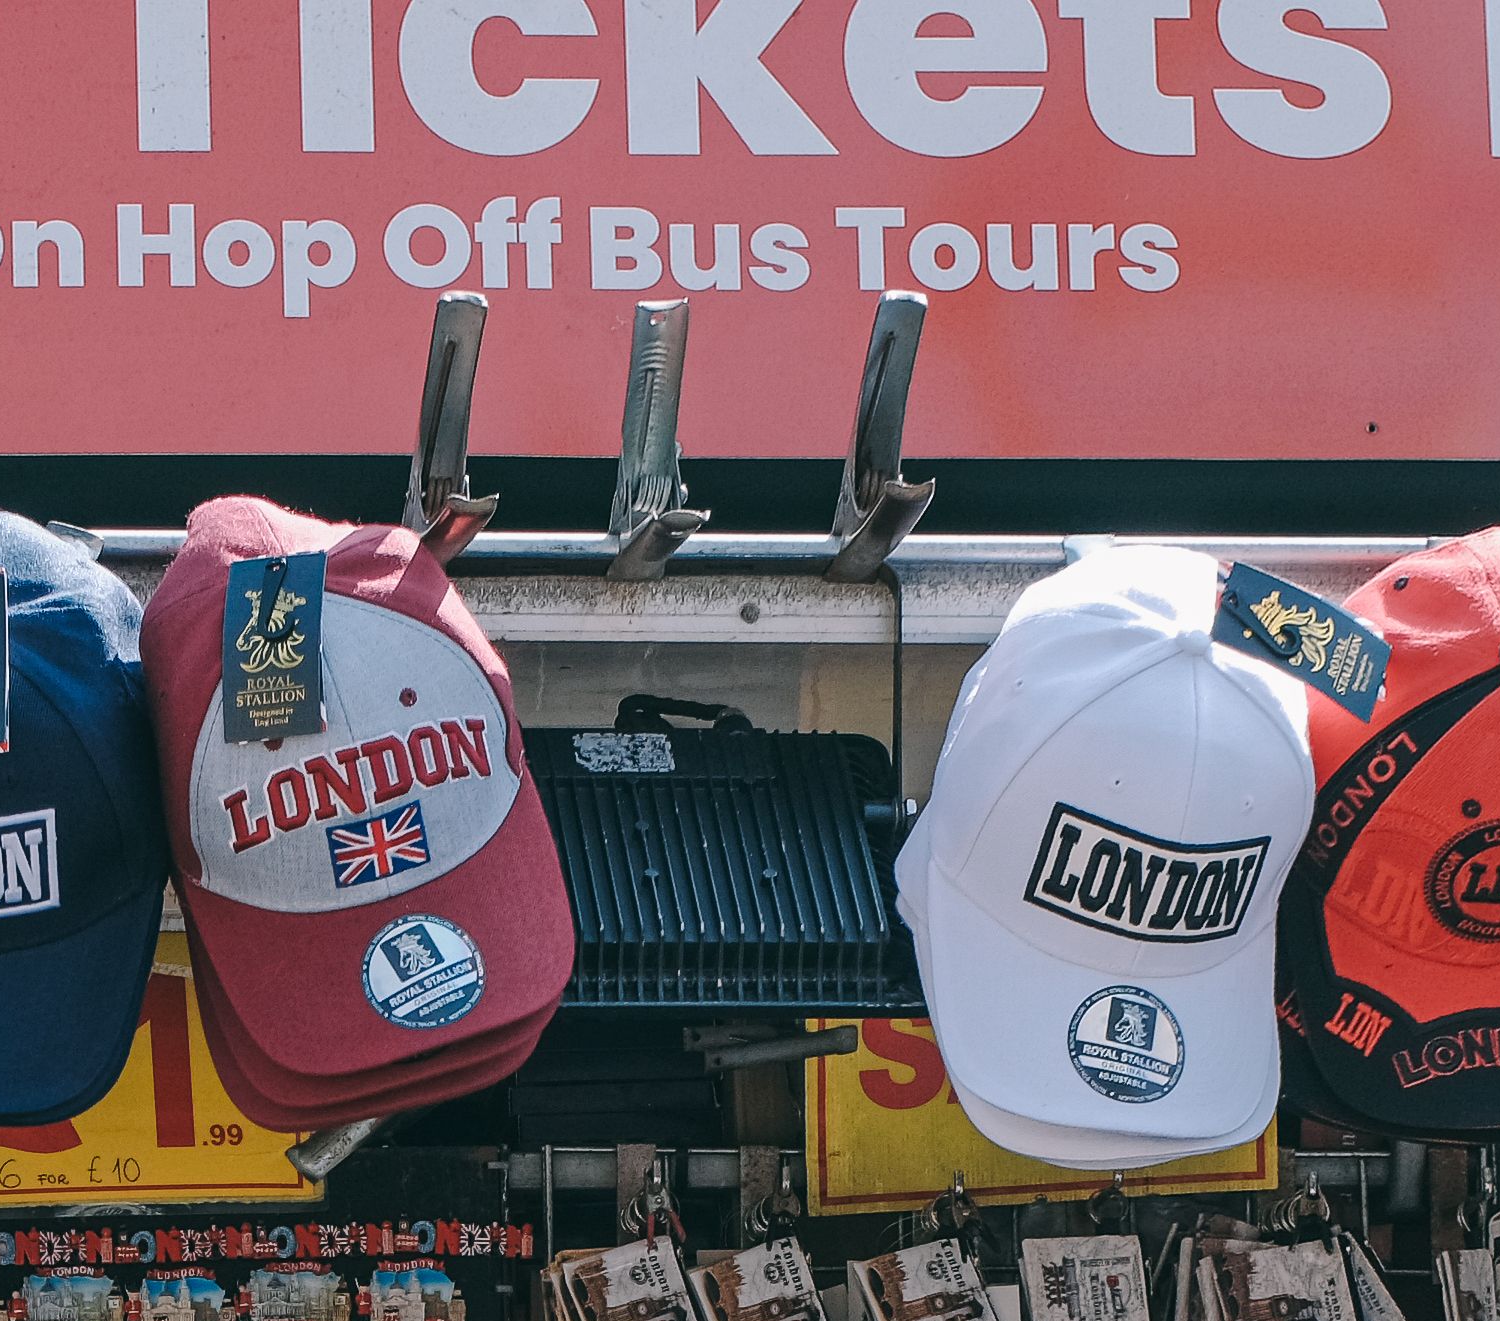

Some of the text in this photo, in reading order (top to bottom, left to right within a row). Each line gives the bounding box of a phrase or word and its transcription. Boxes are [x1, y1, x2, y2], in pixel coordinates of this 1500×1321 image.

[125, 0, 1391, 158] Tickets
[116, 203, 356, 319] Hop
[384, 196, 562, 289] Off
[589, 206, 810, 291] Bus
[836, 207, 1180, 291] Tours
[247, 674, 295, 690] ROYAL
[1327, 638, 1348, 679] ROYAL
[1336, 633, 1363, 696] STALLION
[236, 688, 306, 708] STALLION
[223, 717, 493, 854] LONDON
[1044, 822, 1255, 931] LONDON
[389, 961, 473, 1008] ROYAL STALLION
[1324, 992, 1393, 1058] LDN
[1083, 1043, 1170, 1075] ROYAL STALLION
[1098, 1071, 1147, 1090] ADJUSTABLE
[37, 1173, 70, 1186] FOR
